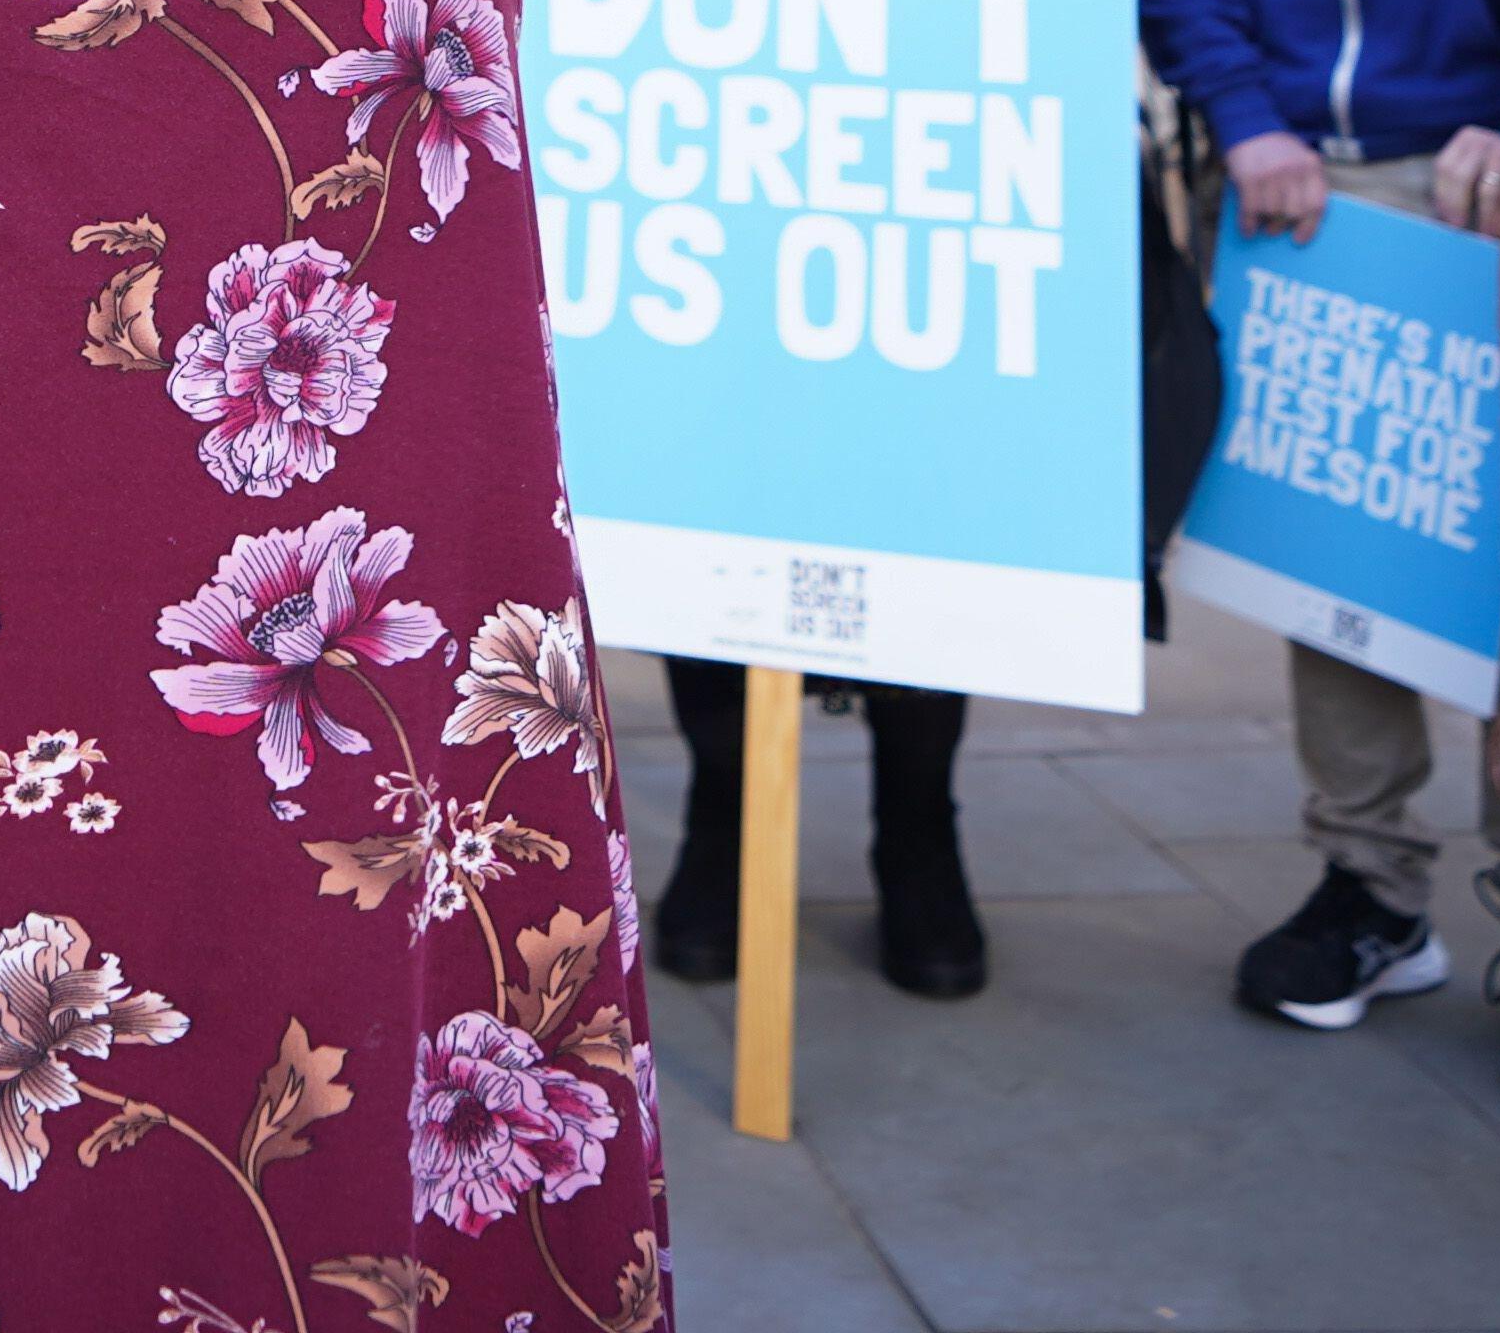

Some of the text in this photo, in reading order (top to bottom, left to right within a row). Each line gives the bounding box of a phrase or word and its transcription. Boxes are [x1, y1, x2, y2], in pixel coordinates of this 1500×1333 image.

[540, 67, 1062, 228] SCREEN
[538, 196, 1063, 377] US OUT
[1245, 267, 1432, 365] THERE'S
[1237, 310, 1493, 445] PRENATAL
[1238, 363, 1485, 493] TEST FOR
[1222, 414, 1483, 552] AWESOME
